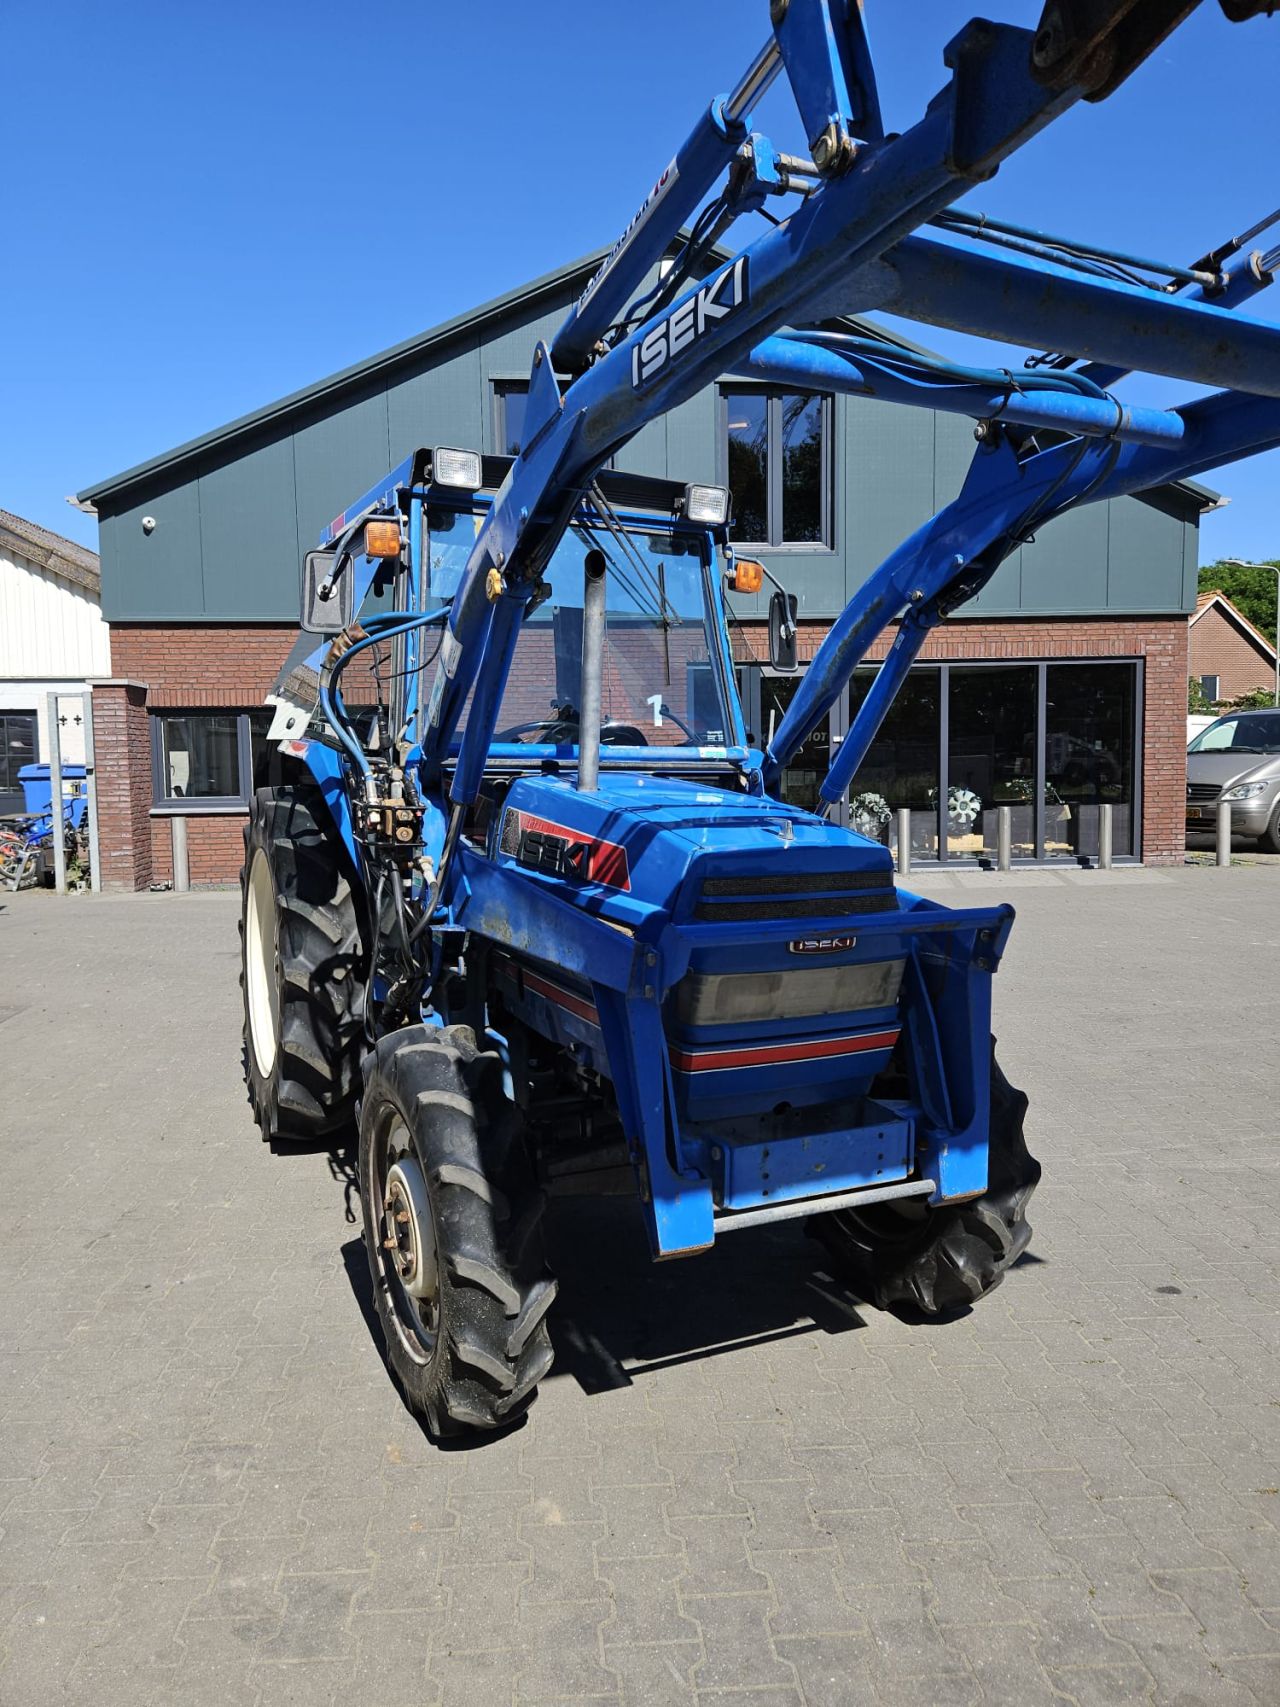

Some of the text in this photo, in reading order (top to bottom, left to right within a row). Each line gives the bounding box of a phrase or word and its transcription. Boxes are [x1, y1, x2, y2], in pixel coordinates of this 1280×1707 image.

[632, 257, 744, 387] ISEKI
[647, 694, 662, 727] 1
[518, 829, 593, 880] ISEKI
[799, 938, 850, 949] ISEKI
